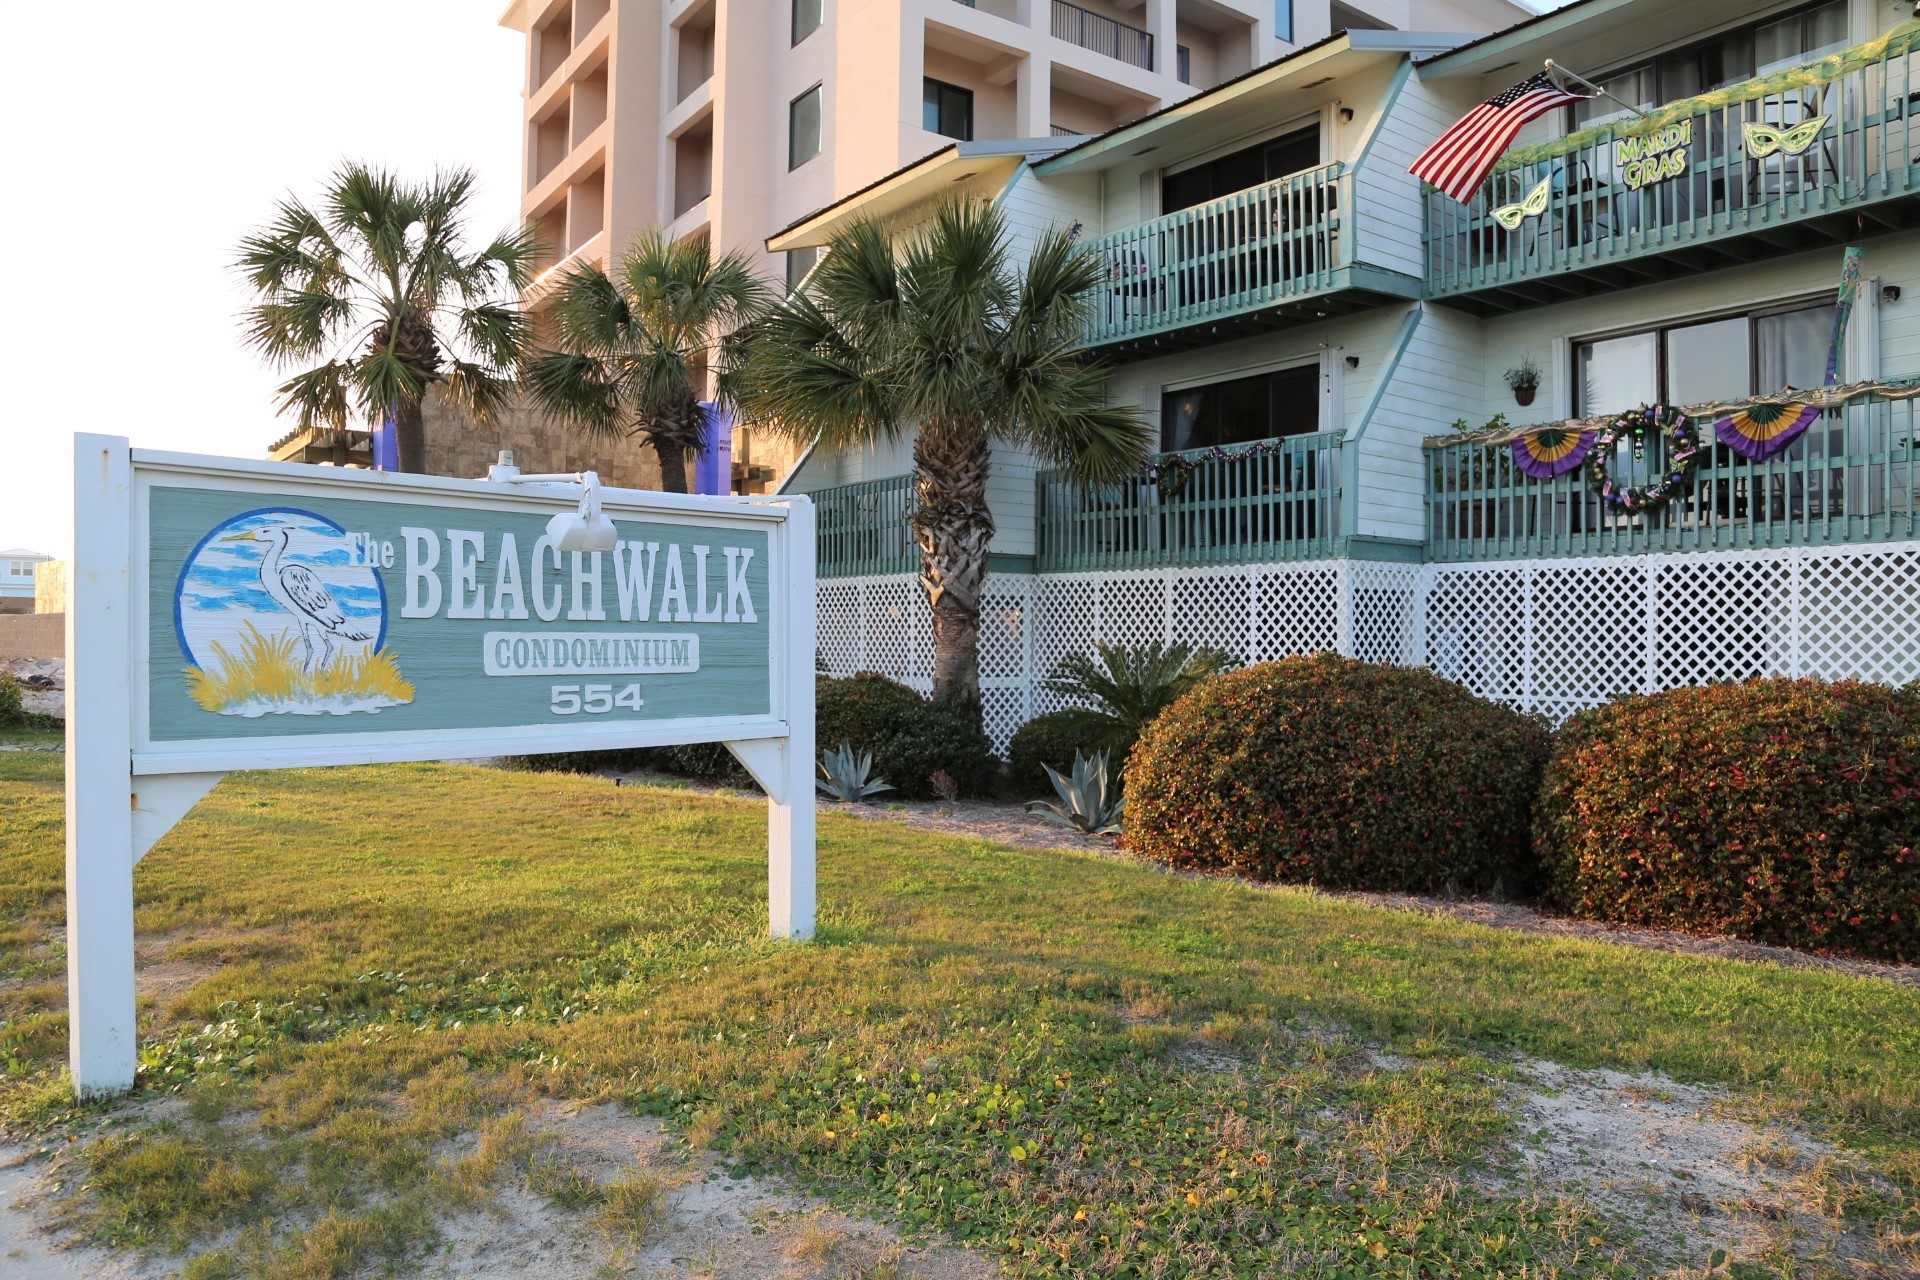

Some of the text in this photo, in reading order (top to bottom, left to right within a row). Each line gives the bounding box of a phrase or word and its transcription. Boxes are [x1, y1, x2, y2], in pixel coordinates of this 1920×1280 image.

[1617, 120, 1691, 166] MARDI
[1624, 150, 1686, 190] GRAS
[400, 526, 758, 623] BEACHWALK
[495, 638, 690, 669] CONDOMINIUM
[551, 683, 644, 715] 554
